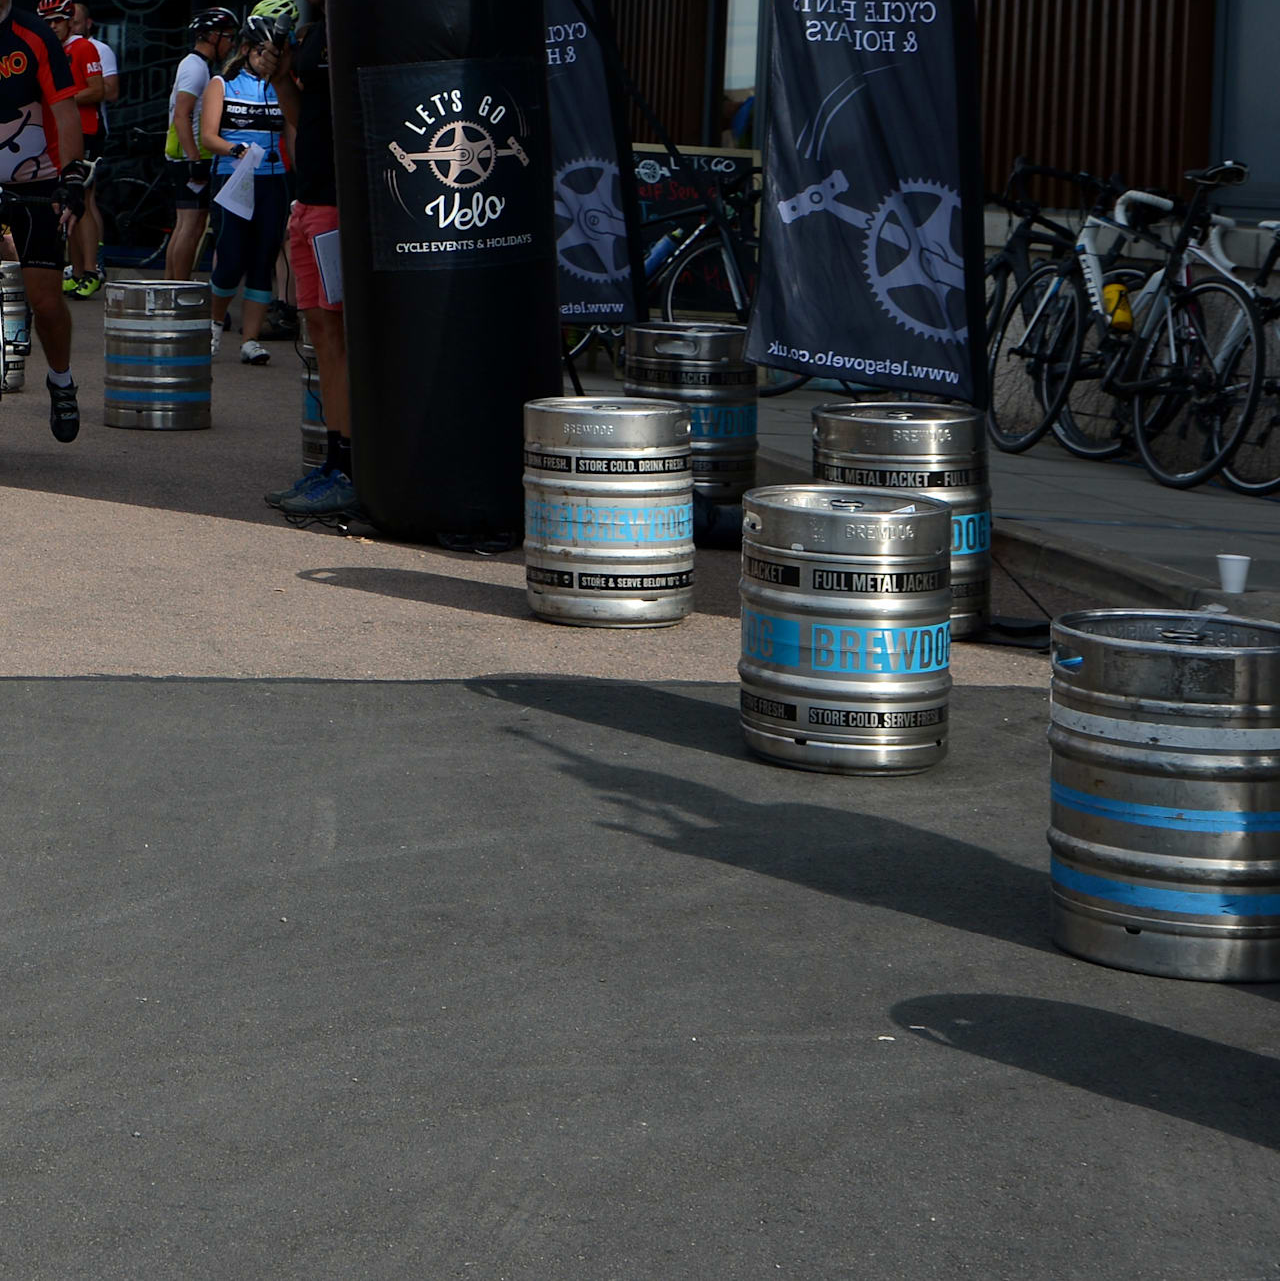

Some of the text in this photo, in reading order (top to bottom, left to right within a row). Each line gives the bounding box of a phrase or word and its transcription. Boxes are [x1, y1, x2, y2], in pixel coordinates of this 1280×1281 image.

[404, 89, 506, 135] LET'S GO
[424, 191, 506, 231] Velo
[395, 233, 533, 254] CYCLE EVENTS & HOLIDAYS
[579, 458, 609, 473] STORE
[610, 458, 636, 472] COLD.
[639, 456, 664, 472] DRINK
[824, 466, 844, 482] FULL
[845, 468, 881, 486] METAL
[885, 471, 931, 488] JACKET
[583, 505, 686, 541] BREWDOG
[581, 575, 606, 587] STORE
[617, 575, 642, 588] SERVE
[643, 575, 667, 588] BELOW
[815, 571, 848, 592] FULL
[852, 572, 899, 594] METAL
[902, 571, 940, 592] JACKET
[809, 707, 846, 726] STORE
[848, 709, 881, 728] COLD.
[883, 710, 916, 728] SERVE
